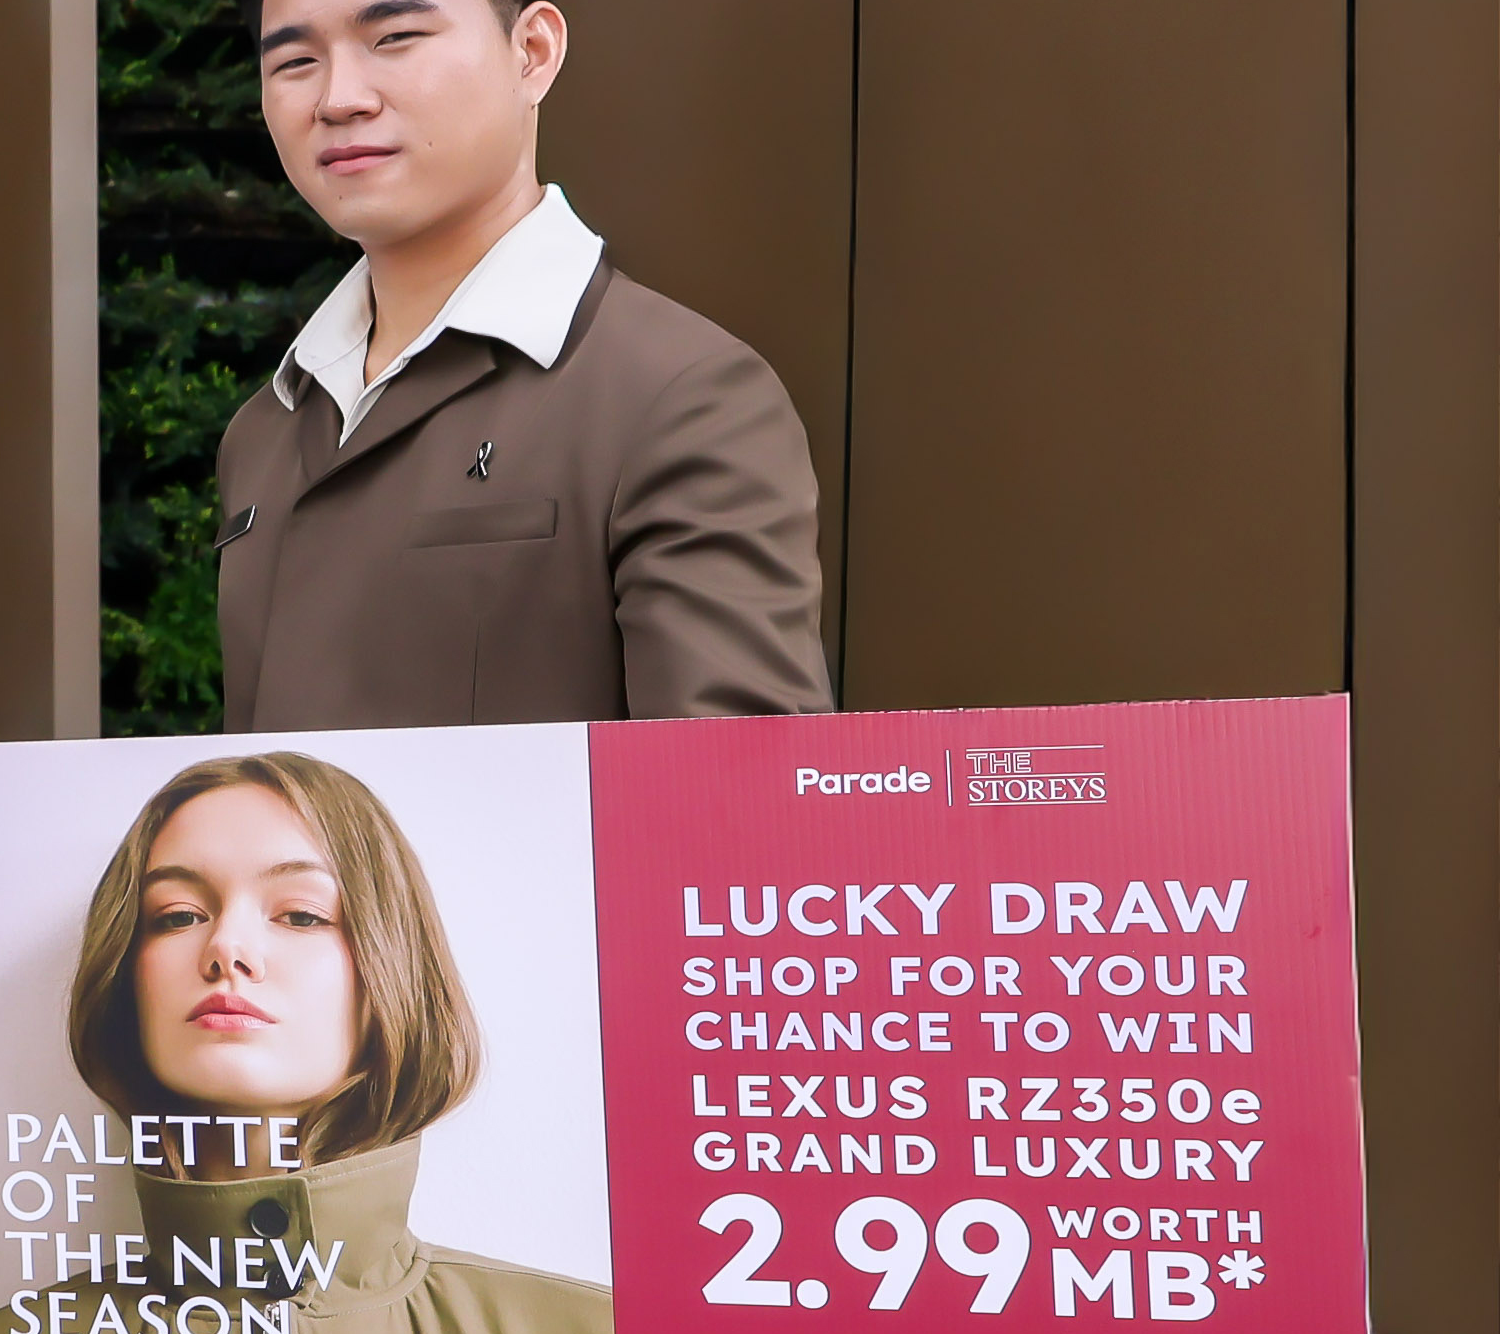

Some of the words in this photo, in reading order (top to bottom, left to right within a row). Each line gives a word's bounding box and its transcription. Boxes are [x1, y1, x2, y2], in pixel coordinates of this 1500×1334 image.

[796, 765, 931, 795] Parade
[966, 751, 1032, 774] THE
[967, 777, 1106, 802] STOREYS
[683, 883, 956, 937] LUCKY
[990, 879, 1248, 935] DRAW
[682, 956, 858, 996] SHOP
[890, 955, 1022, 996] FOR
[1049, 955, 1248, 996] YOUR
[685, 1011, 952, 1052] CHANCE
[980, 1011, 1070, 1053] TO
[1098, 1012, 1254, 1054] WIN
[692, 1074, 928, 1120] LEXUS
[967, 1077, 1261, 1124] RZ350e
[7, 1113, 302, 1168] PALETTE
[693, 1131, 937, 1175] GRAND
[973, 1136, 1265, 1182] LUXURY
[2, 1170, 95, 1223] OF
[1047, 1205, 1262, 1244] WORTH
[4, 1230, 148, 1285] THE
[172, 1234, 346, 1292] NEW
[698, 1193, 1031, 1314] 2.99
